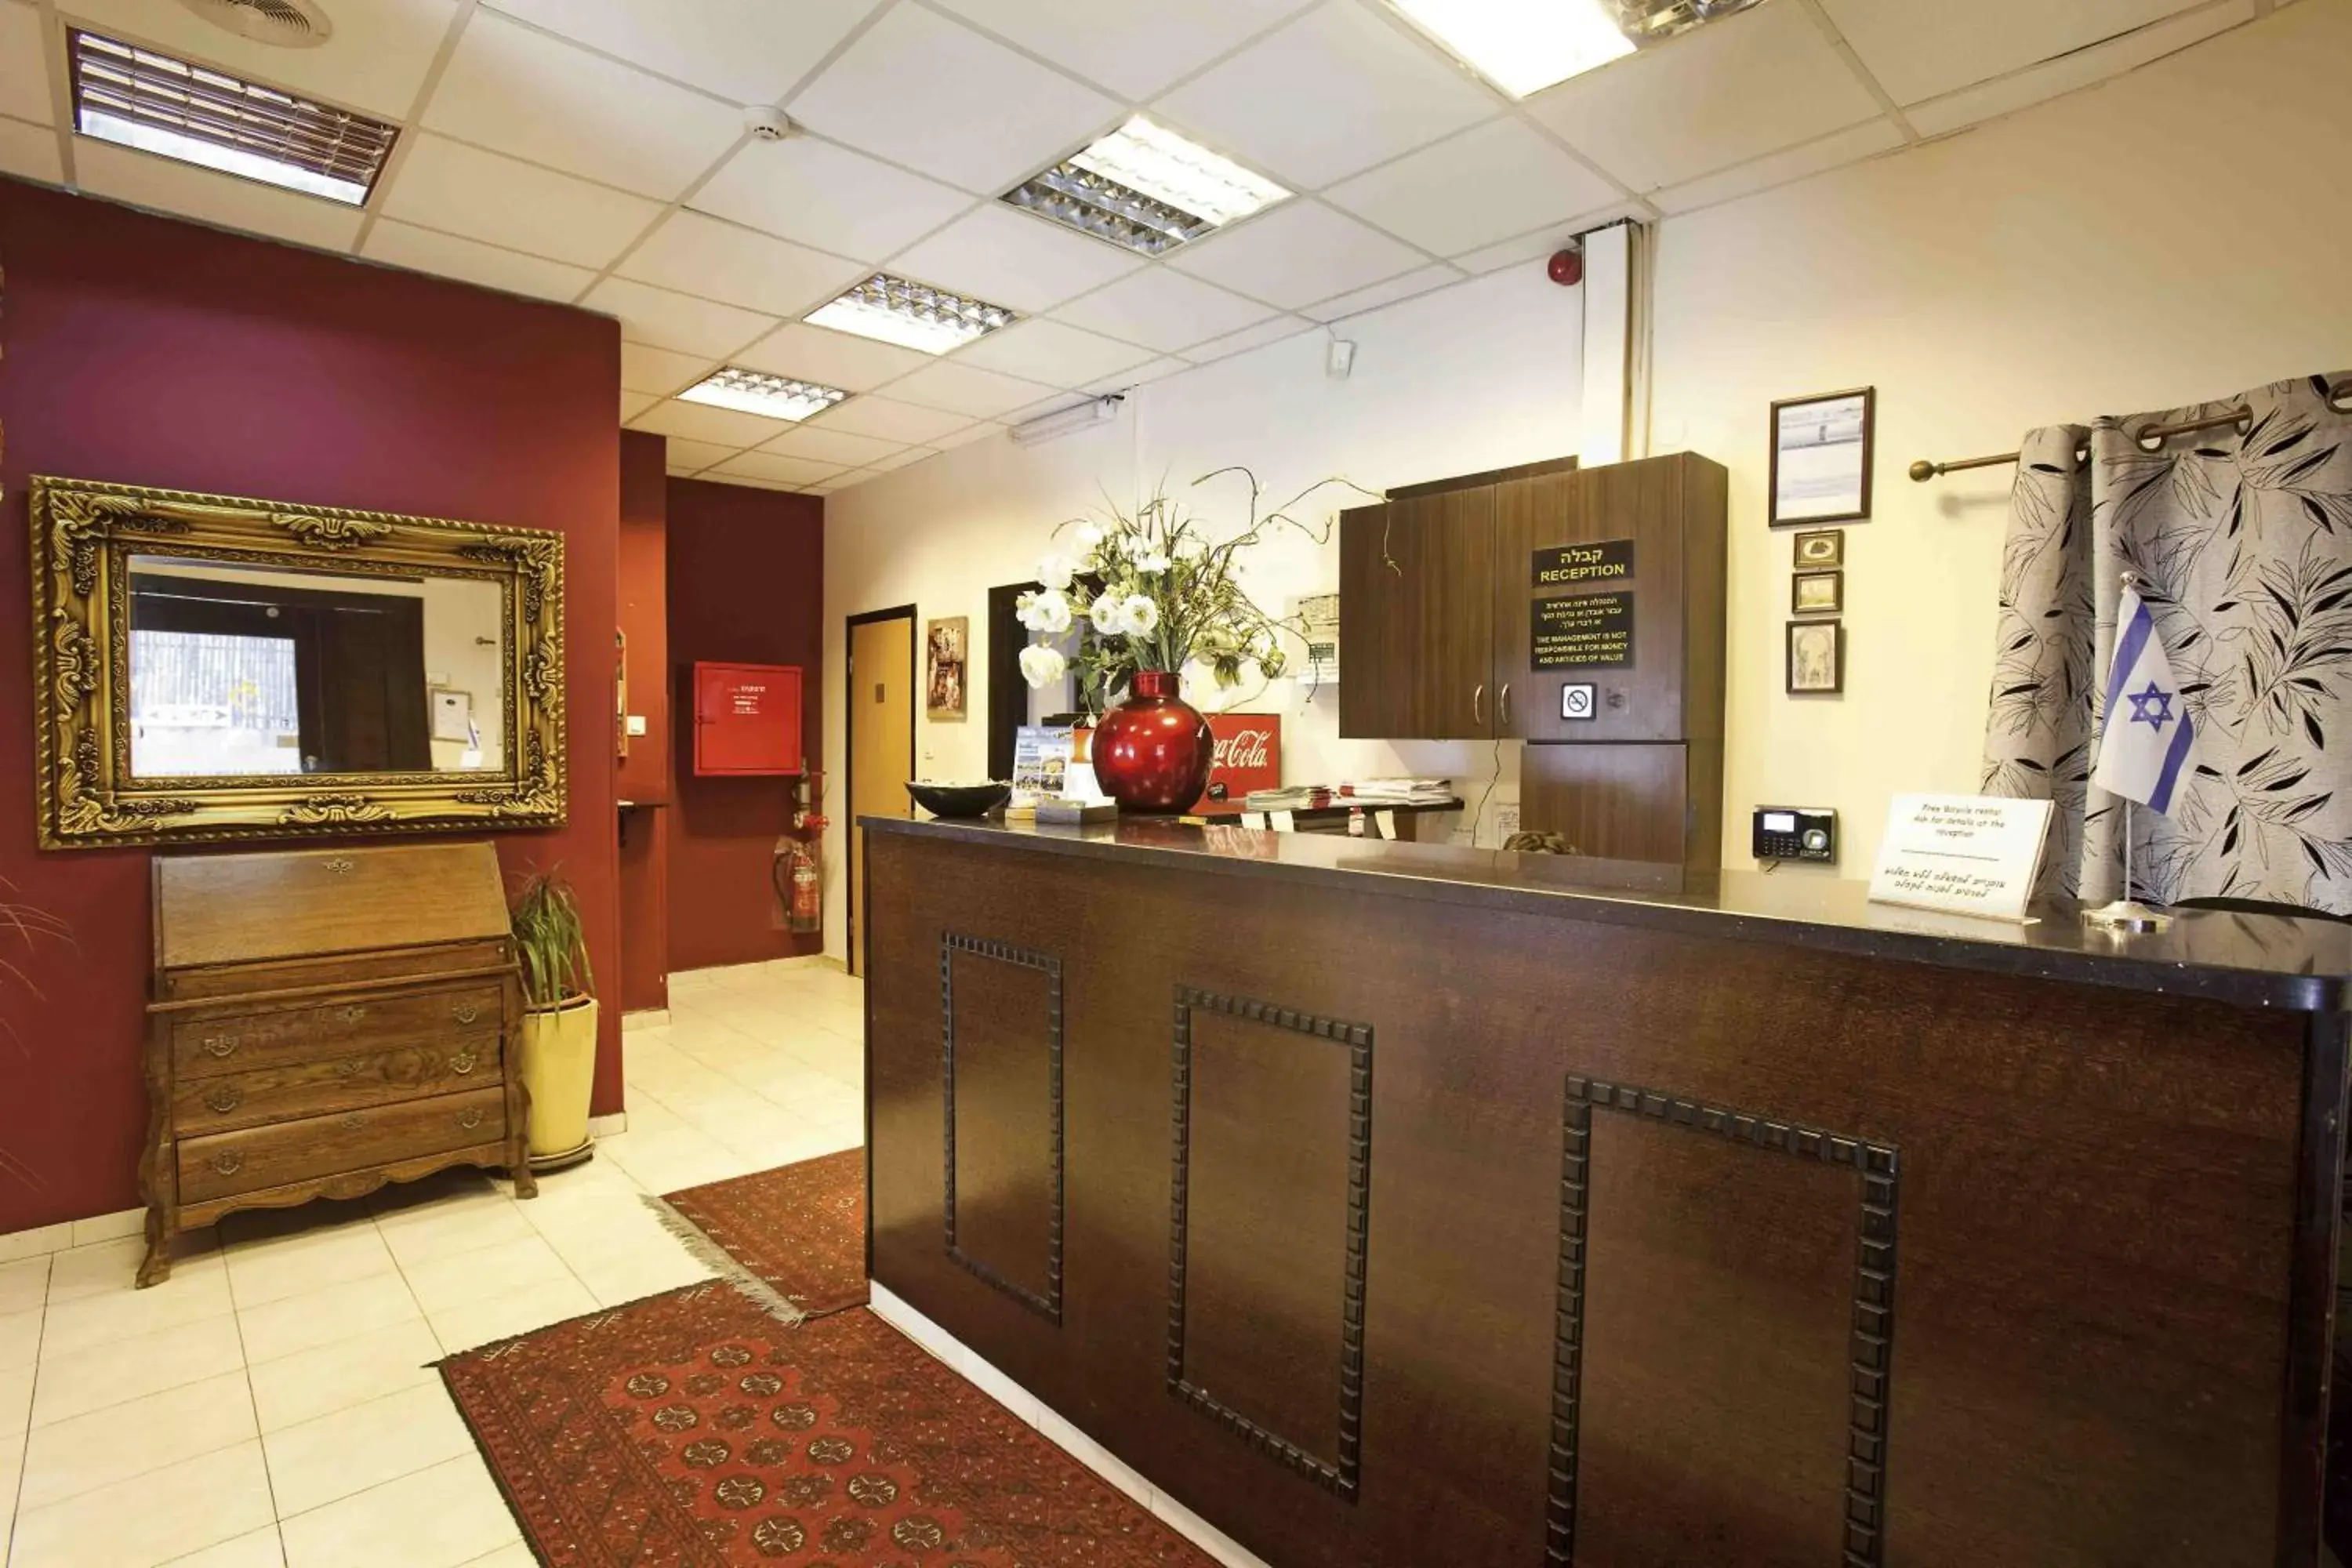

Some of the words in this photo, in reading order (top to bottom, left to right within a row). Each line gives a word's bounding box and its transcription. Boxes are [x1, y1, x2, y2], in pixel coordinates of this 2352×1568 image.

[1561, 549, 1602, 564] קבלה
[1541, 564, 1625, 583] RECEPTION
[1551, 633, 1601, 642] MANAGEMENT
[1535, 644, 1583, 654] RESPONSIBLE
[1555, 655, 1587, 663] ARTICLES
